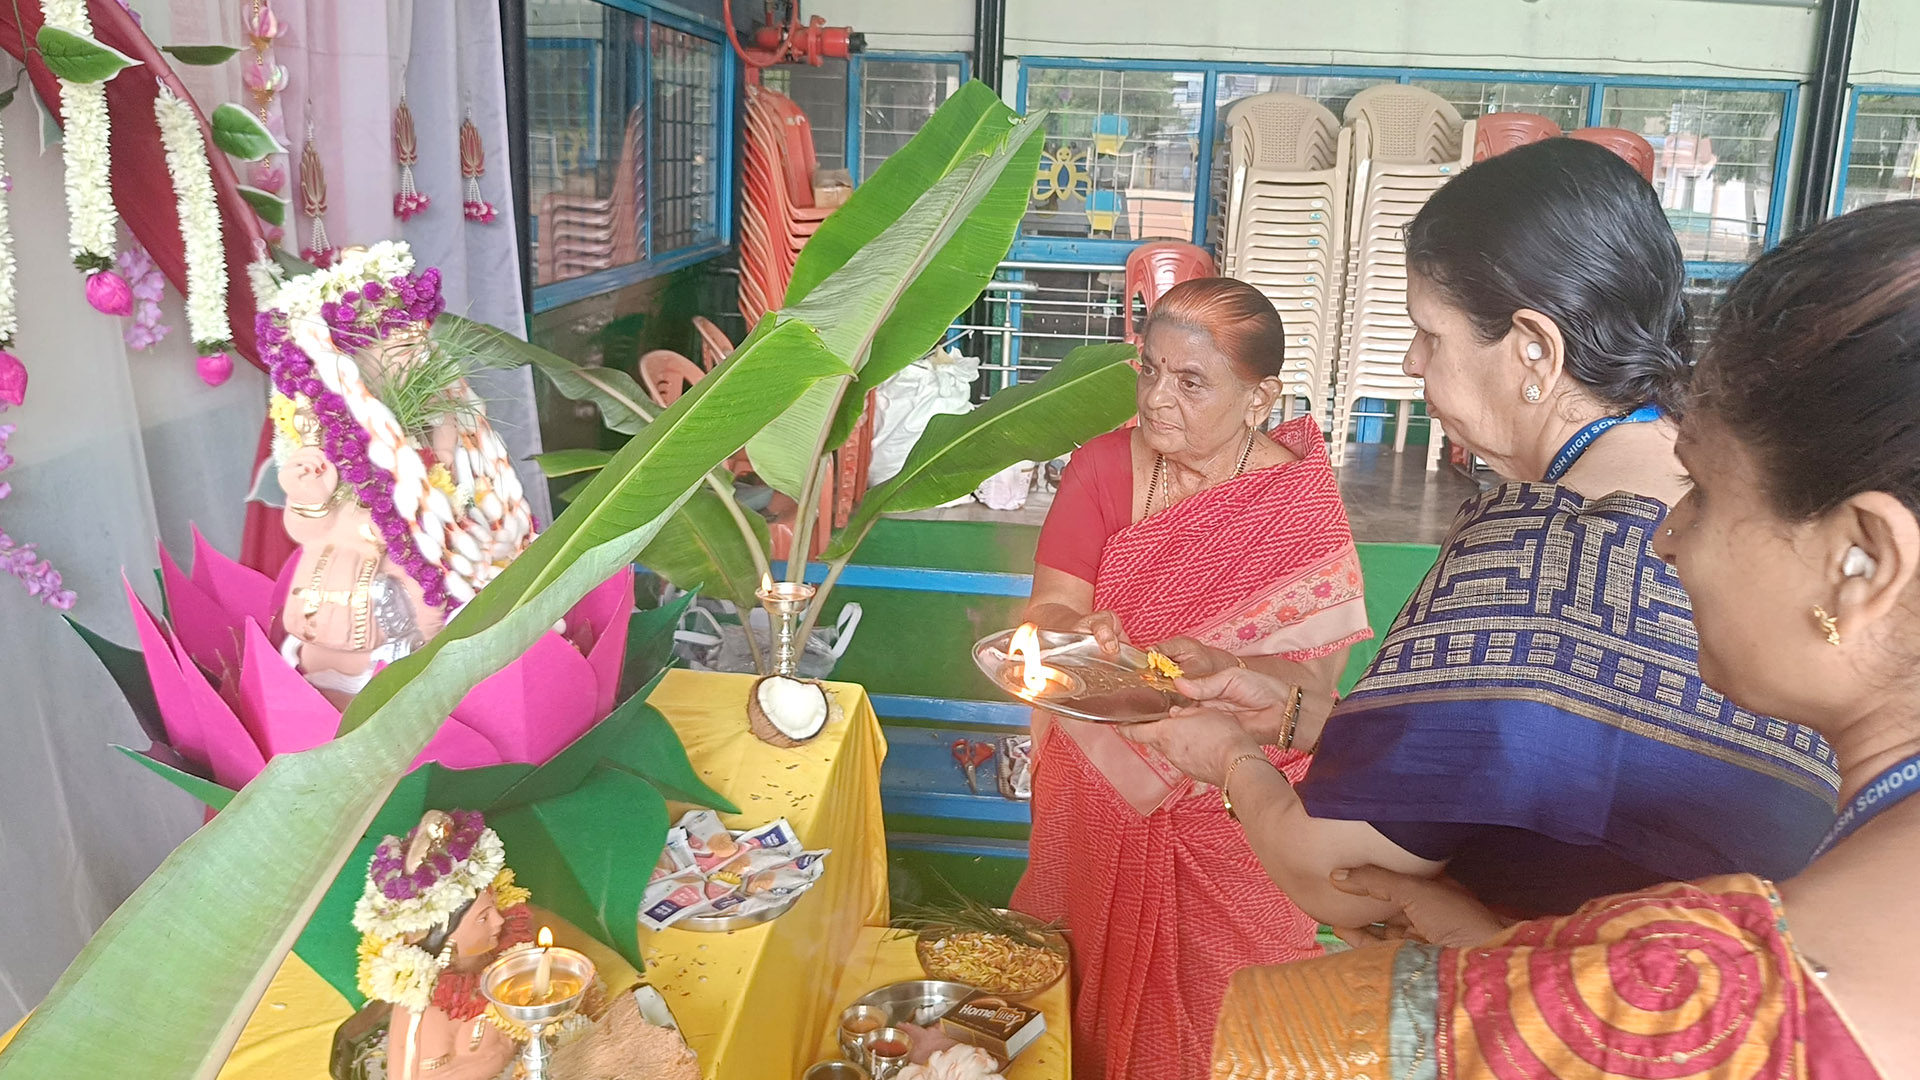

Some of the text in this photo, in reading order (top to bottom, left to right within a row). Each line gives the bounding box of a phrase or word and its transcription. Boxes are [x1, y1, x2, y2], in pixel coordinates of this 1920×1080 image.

[1547, 456, 1568, 480] LISH
[1566, 432, 1591, 458] HIGH
[1855, 758, 1920, 812] SCHOO
